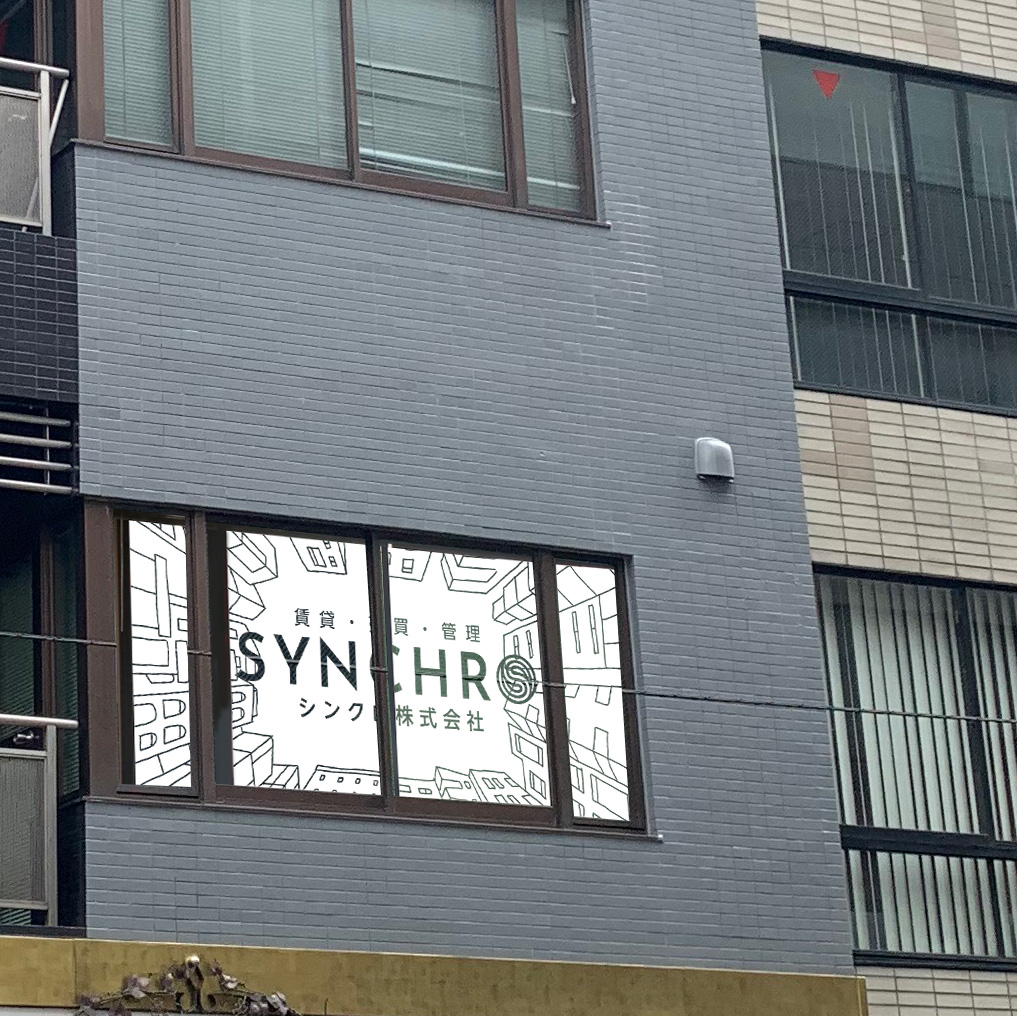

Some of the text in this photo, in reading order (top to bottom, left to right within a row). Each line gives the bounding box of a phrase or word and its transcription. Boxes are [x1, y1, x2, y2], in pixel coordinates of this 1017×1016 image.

[294, 608, 481, 643] 賃貸・買・管理
[300, 698, 485, 732] シンク株式会社
